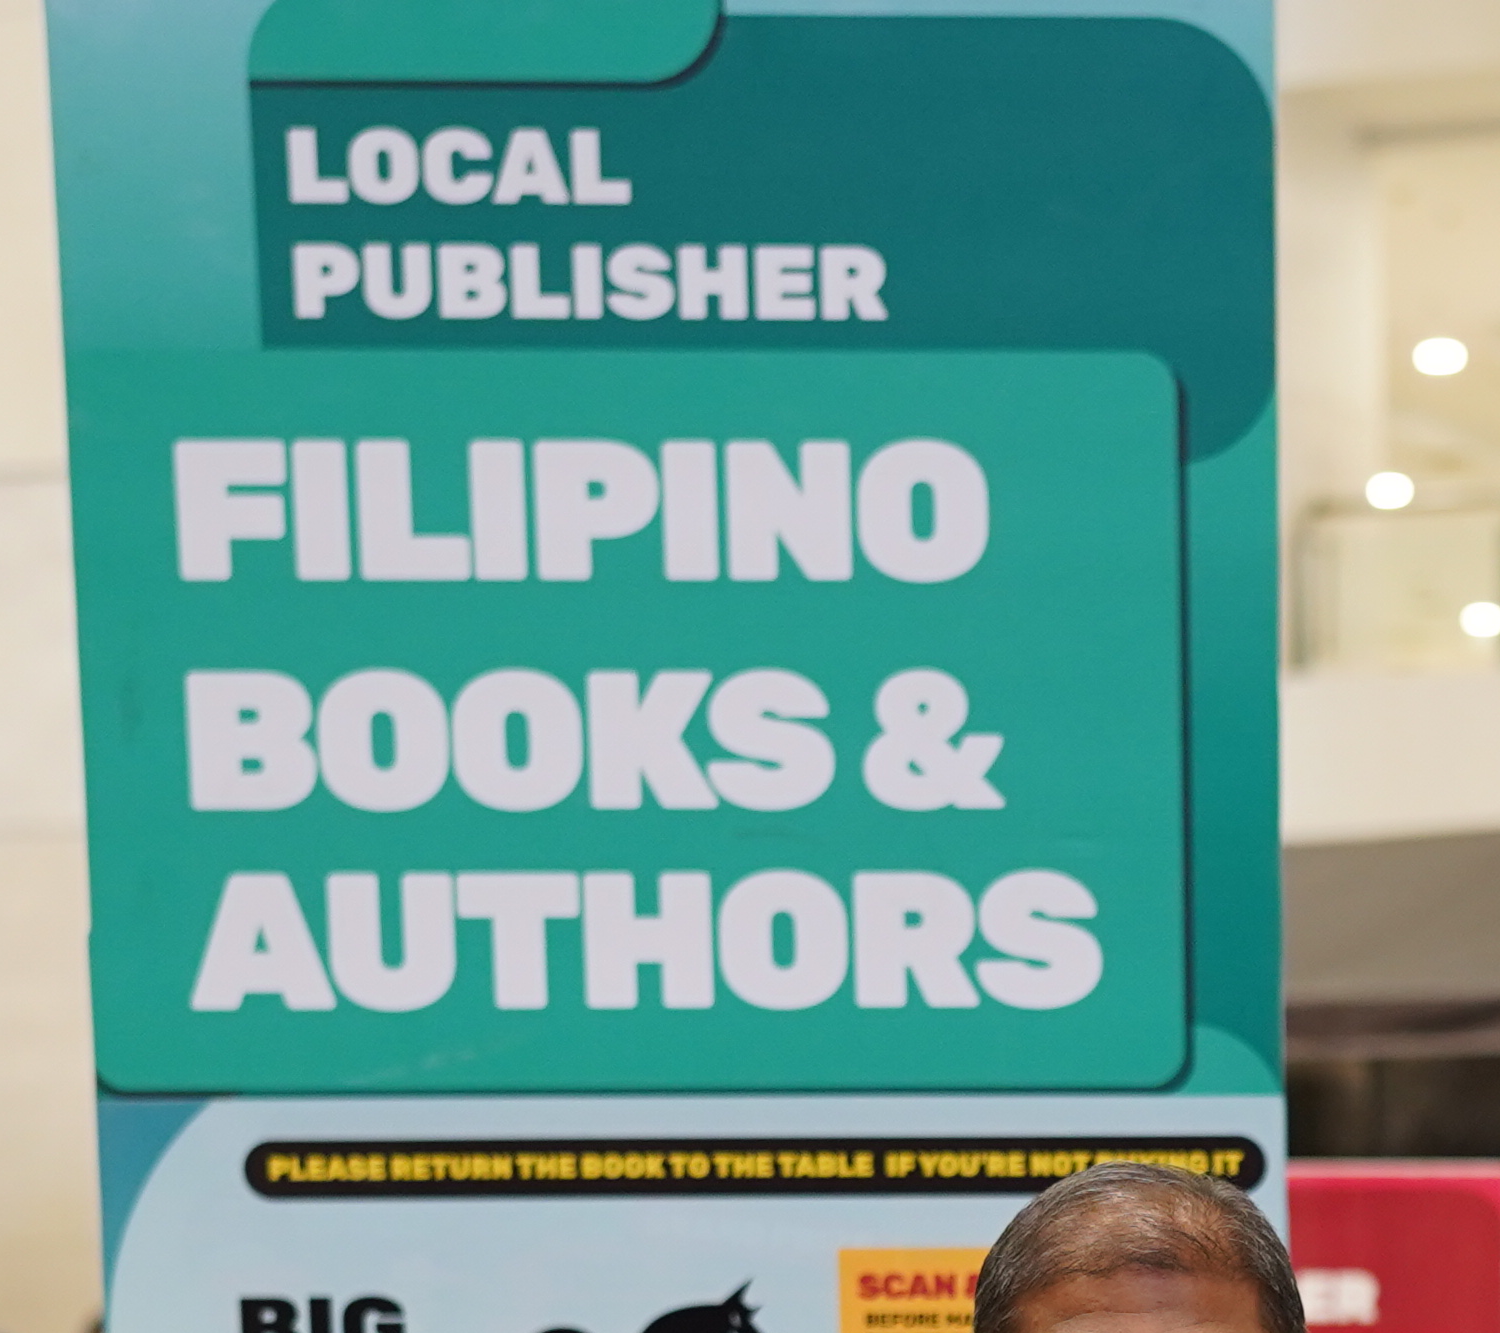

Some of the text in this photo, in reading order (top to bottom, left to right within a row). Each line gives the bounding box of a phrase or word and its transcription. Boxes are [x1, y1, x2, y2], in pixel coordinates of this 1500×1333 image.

[286, 127, 631, 204] LOCAL
[292, 243, 887, 321] PUBLISHER
[173, 438, 990, 584] FILIPINO
[184, 667, 1006, 813] BOOKS &
[190, 869, 1103, 1012] AUTHORS
[266, 1153, 385, 1182] PLEASE
[390, 1153, 512, 1181] RETURN
[516, 1153, 577, 1180] THE
[581, 1152, 667, 1180] BOOK
[669, 1152, 710, 1179] TO
[714, 1151, 774, 1179] THE
[778, 1151, 874, 1178] TABLE
[885, 1150, 915, 1177] IF
[917, 1150, 1026, 1177] YOU'RE
[1029, 1150, 1092, 1177] NOT
[1211, 1150, 1245, 1177] IT
[858, 1274, 955, 1299] SCAN
